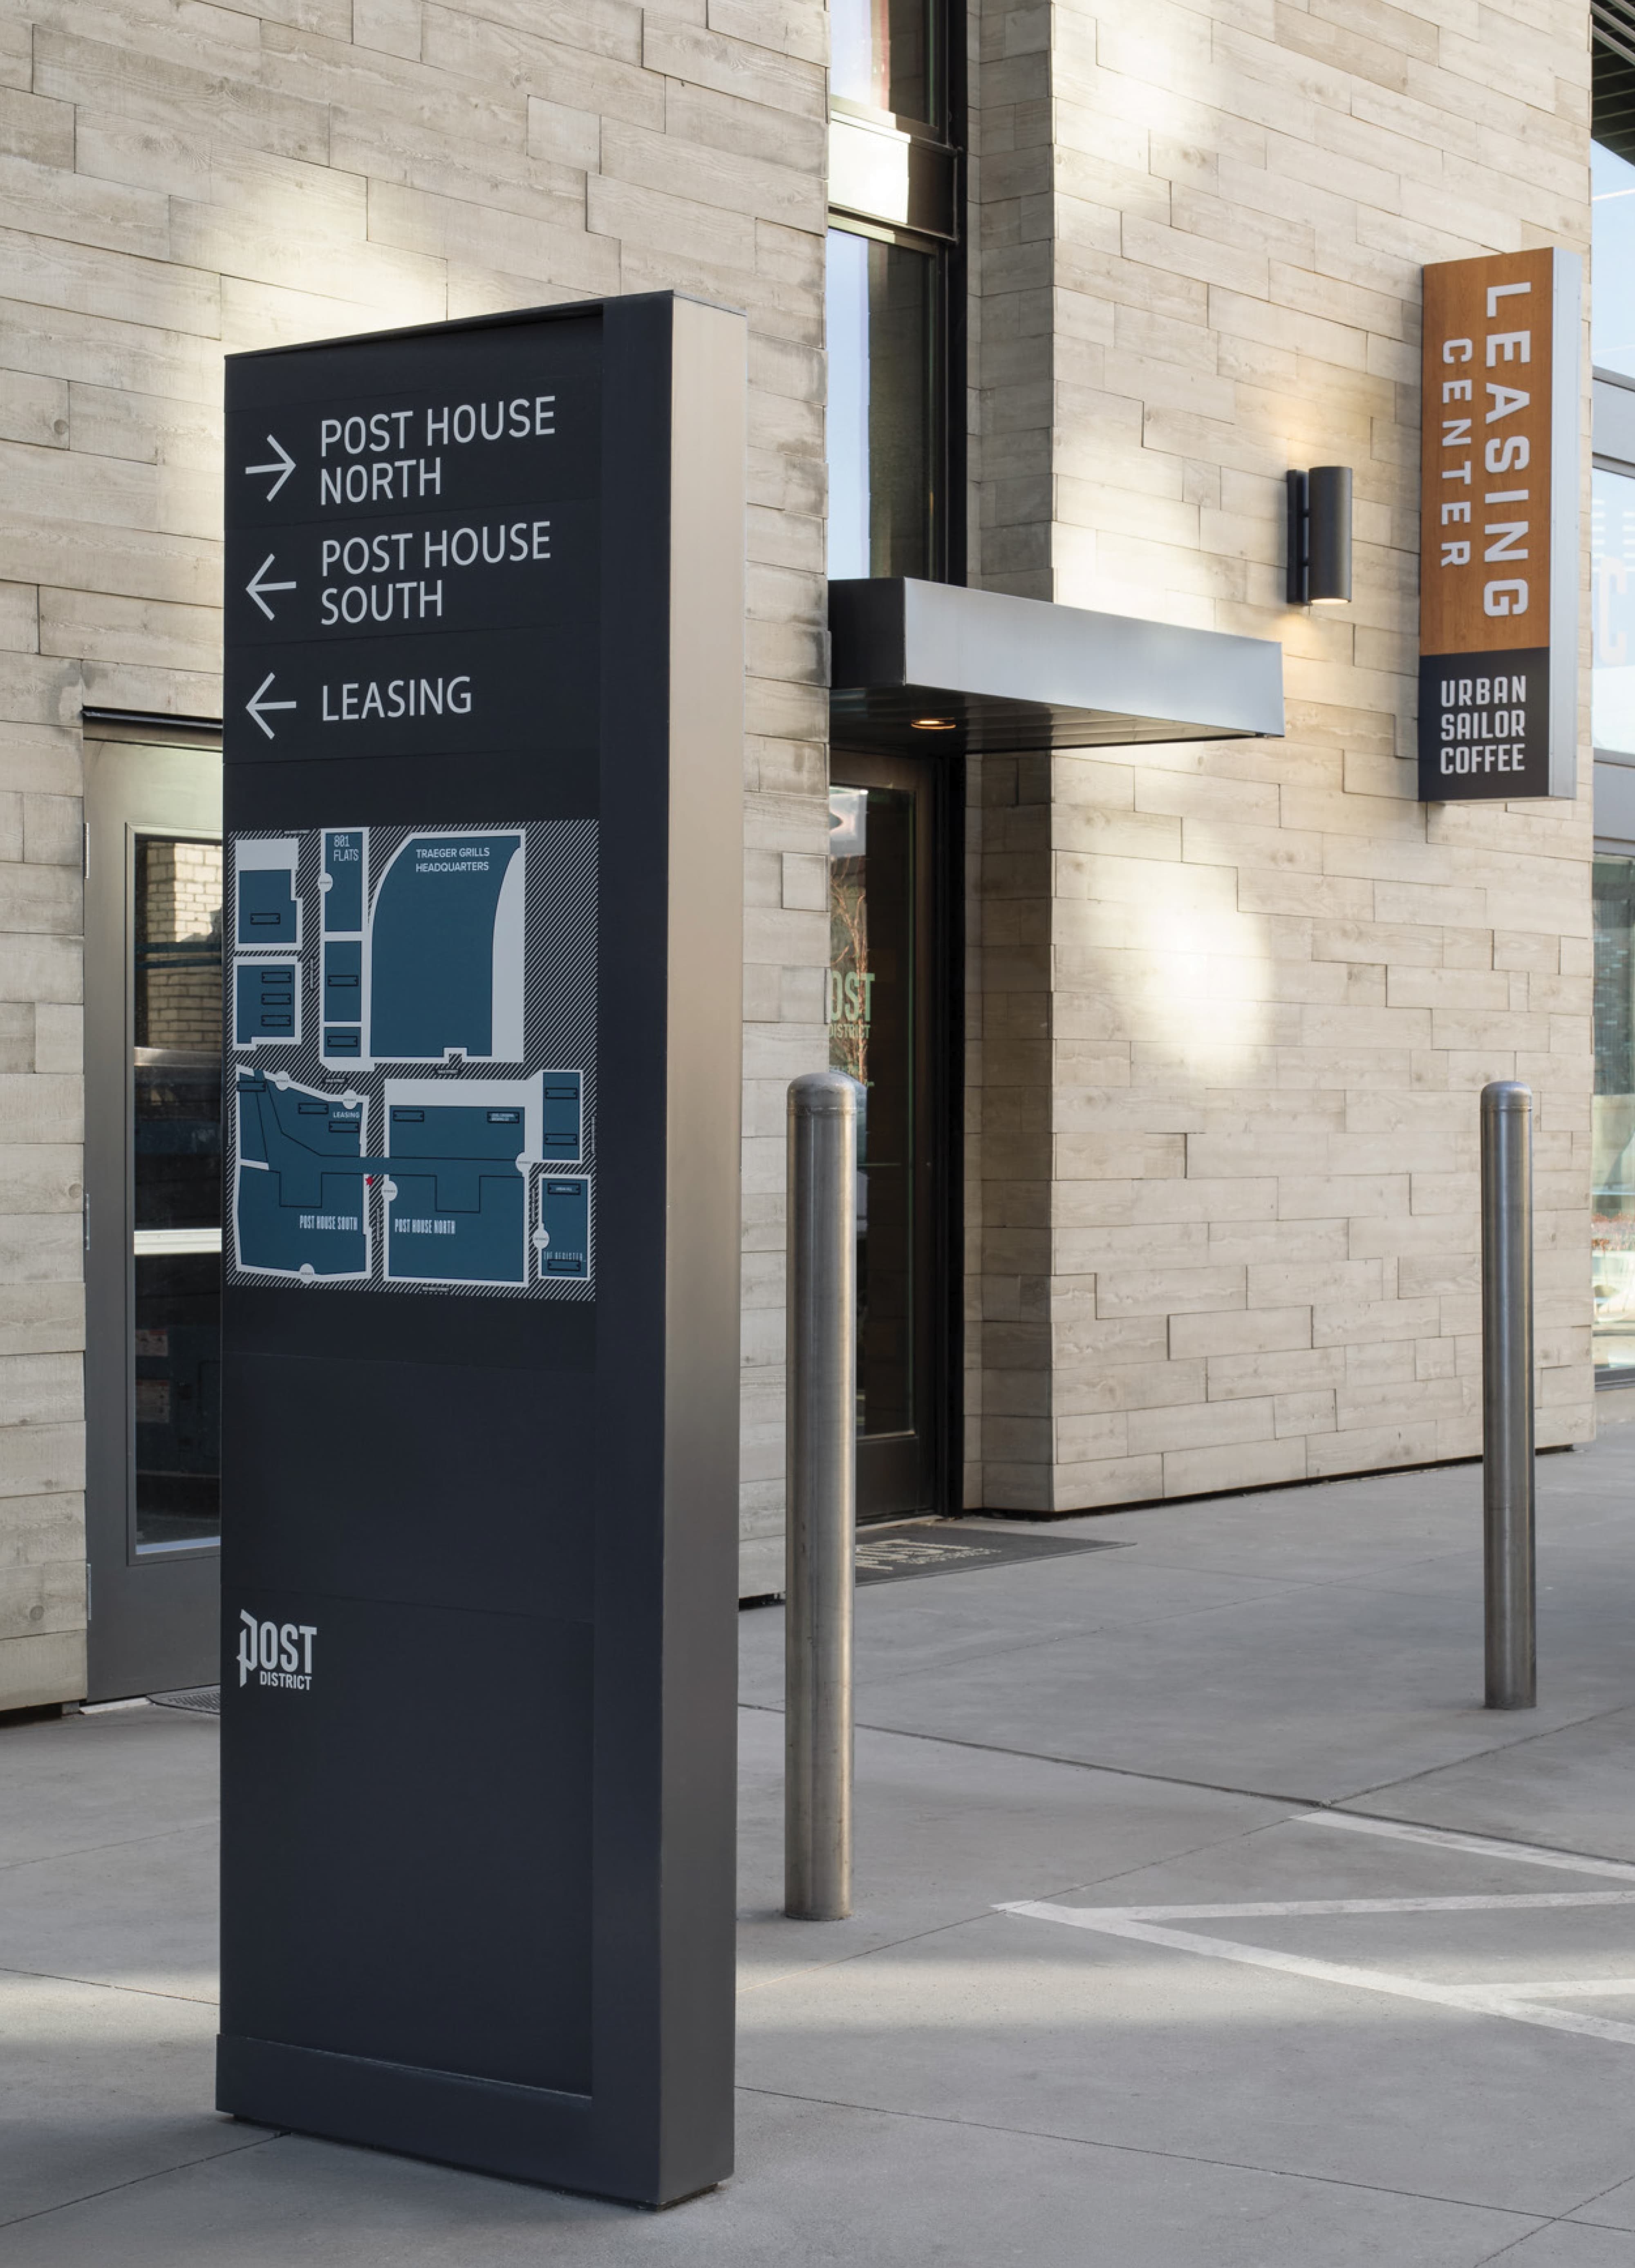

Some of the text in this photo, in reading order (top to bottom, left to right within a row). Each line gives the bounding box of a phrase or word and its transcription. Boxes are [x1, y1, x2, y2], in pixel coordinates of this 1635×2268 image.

[322, 396, 555, 457] POST HOUSE
[1440, 338, 1473, 567] CENTER
[1483, 282, 1531, 617] LEASING
[321, 457, 441, 505] NORTH
[322, 521, 551, 577] POST HOUSE
[321, 580, 442, 625] SOUTH
[322, 676, 472, 721] LEASING
[1441, 675, 1526, 707] URBAN
[1440, 709, 1526, 741] SAILOR
[1440, 743, 1525, 775] COFFEE
[334, 849, 360, 861] FLATS
[416, 847, 490, 858] TRAEGER GRILLS
[416, 861, 490, 872] HEADQUARTERS
[830, 970, 876, 1022] OST
[299, 1215, 315, 1230] POST
[316, 1215, 336, 1230] HOUSE
[337, 1215, 358, 1231] SOUTH
[394, 1218, 410, 1233] POST
[412, 1219, 432, 1234] HOUSE
[434, 1219, 456, 1235] NORTH
[236, 1609, 317, 1688] POST
[260, 1671, 312, 1691] DISTRICT
